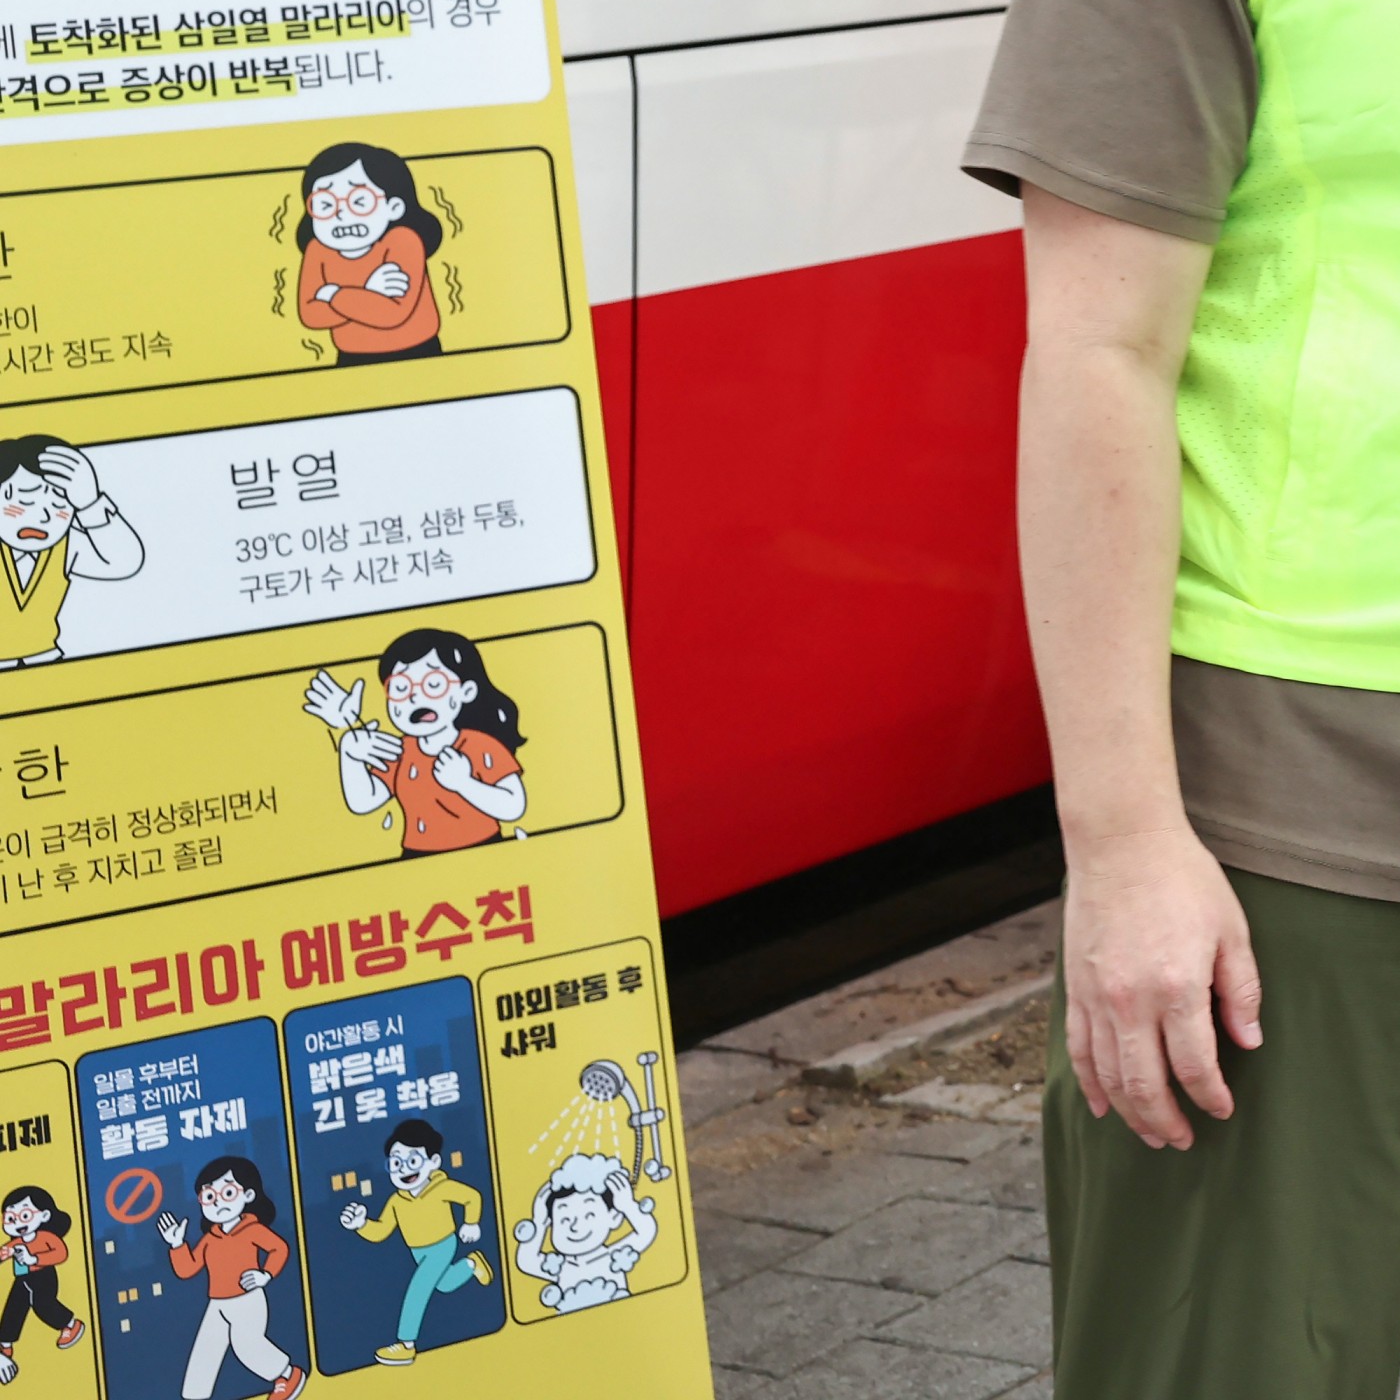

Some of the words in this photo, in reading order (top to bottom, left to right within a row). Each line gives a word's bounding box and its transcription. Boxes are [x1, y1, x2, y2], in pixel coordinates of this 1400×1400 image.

[29, 14, 163, 56] 토착화된
[174, 7, 271, 48] 삼일열
[0, 71, 110, 113] 격으로
[120, 61, 218, 104] 증상이
[228, 48, 394, 95] 반복됩니다.
[0, 342, 54, 375] 시간
[63, 337, 115, 369] 정도
[122, 330, 173, 361] 지속
[302, 523, 350, 554] 이상
[358, 515, 411, 547] 고열,
[420, 506, 466, 539] 심한
[473, 499, 525, 531] 두통,
[239, 566, 313, 604] 구토가
[320, 564, 345, 592] 수
[353, 554, 399, 586] 시간
[407, 548, 455, 577] 지속
[40, 813, 119, 856] 급격히
[127, 785, 278, 840] 정상화되면서
[18, 868, 44, 900] 난
[53, 862, 80, 893] 후
[87, 848, 167, 885] 지치고
[173, 835, 223, 873] 졸림
[0, 938, 265, 1052] 말라리아
[280, 884, 535, 992] 예방수칙
[496, 973, 608, 1021] 야외활동
[617, 966, 643, 994] 후
[305, 1020, 381, 1053] 야간활동
[385, 1014, 404, 1037] 시
[501, 1022, 557, 1058] 샤워
[93, 1067, 135, 1096] 일몰
[139, 1053, 199, 1086] 후부터
[308, 1043, 407, 1095] 밝은색
[96, 1093, 137, 1121] 일출
[141, 1079, 201, 1111] 전까지
[312, 1096, 347, 1134] 긴
[355, 1087, 389, 1123] 옷
[396, 1071, 461, 1111] 착용
[100, 1114, 170, 1161] 활동
[179, 1097, 247, 1141] 자제
